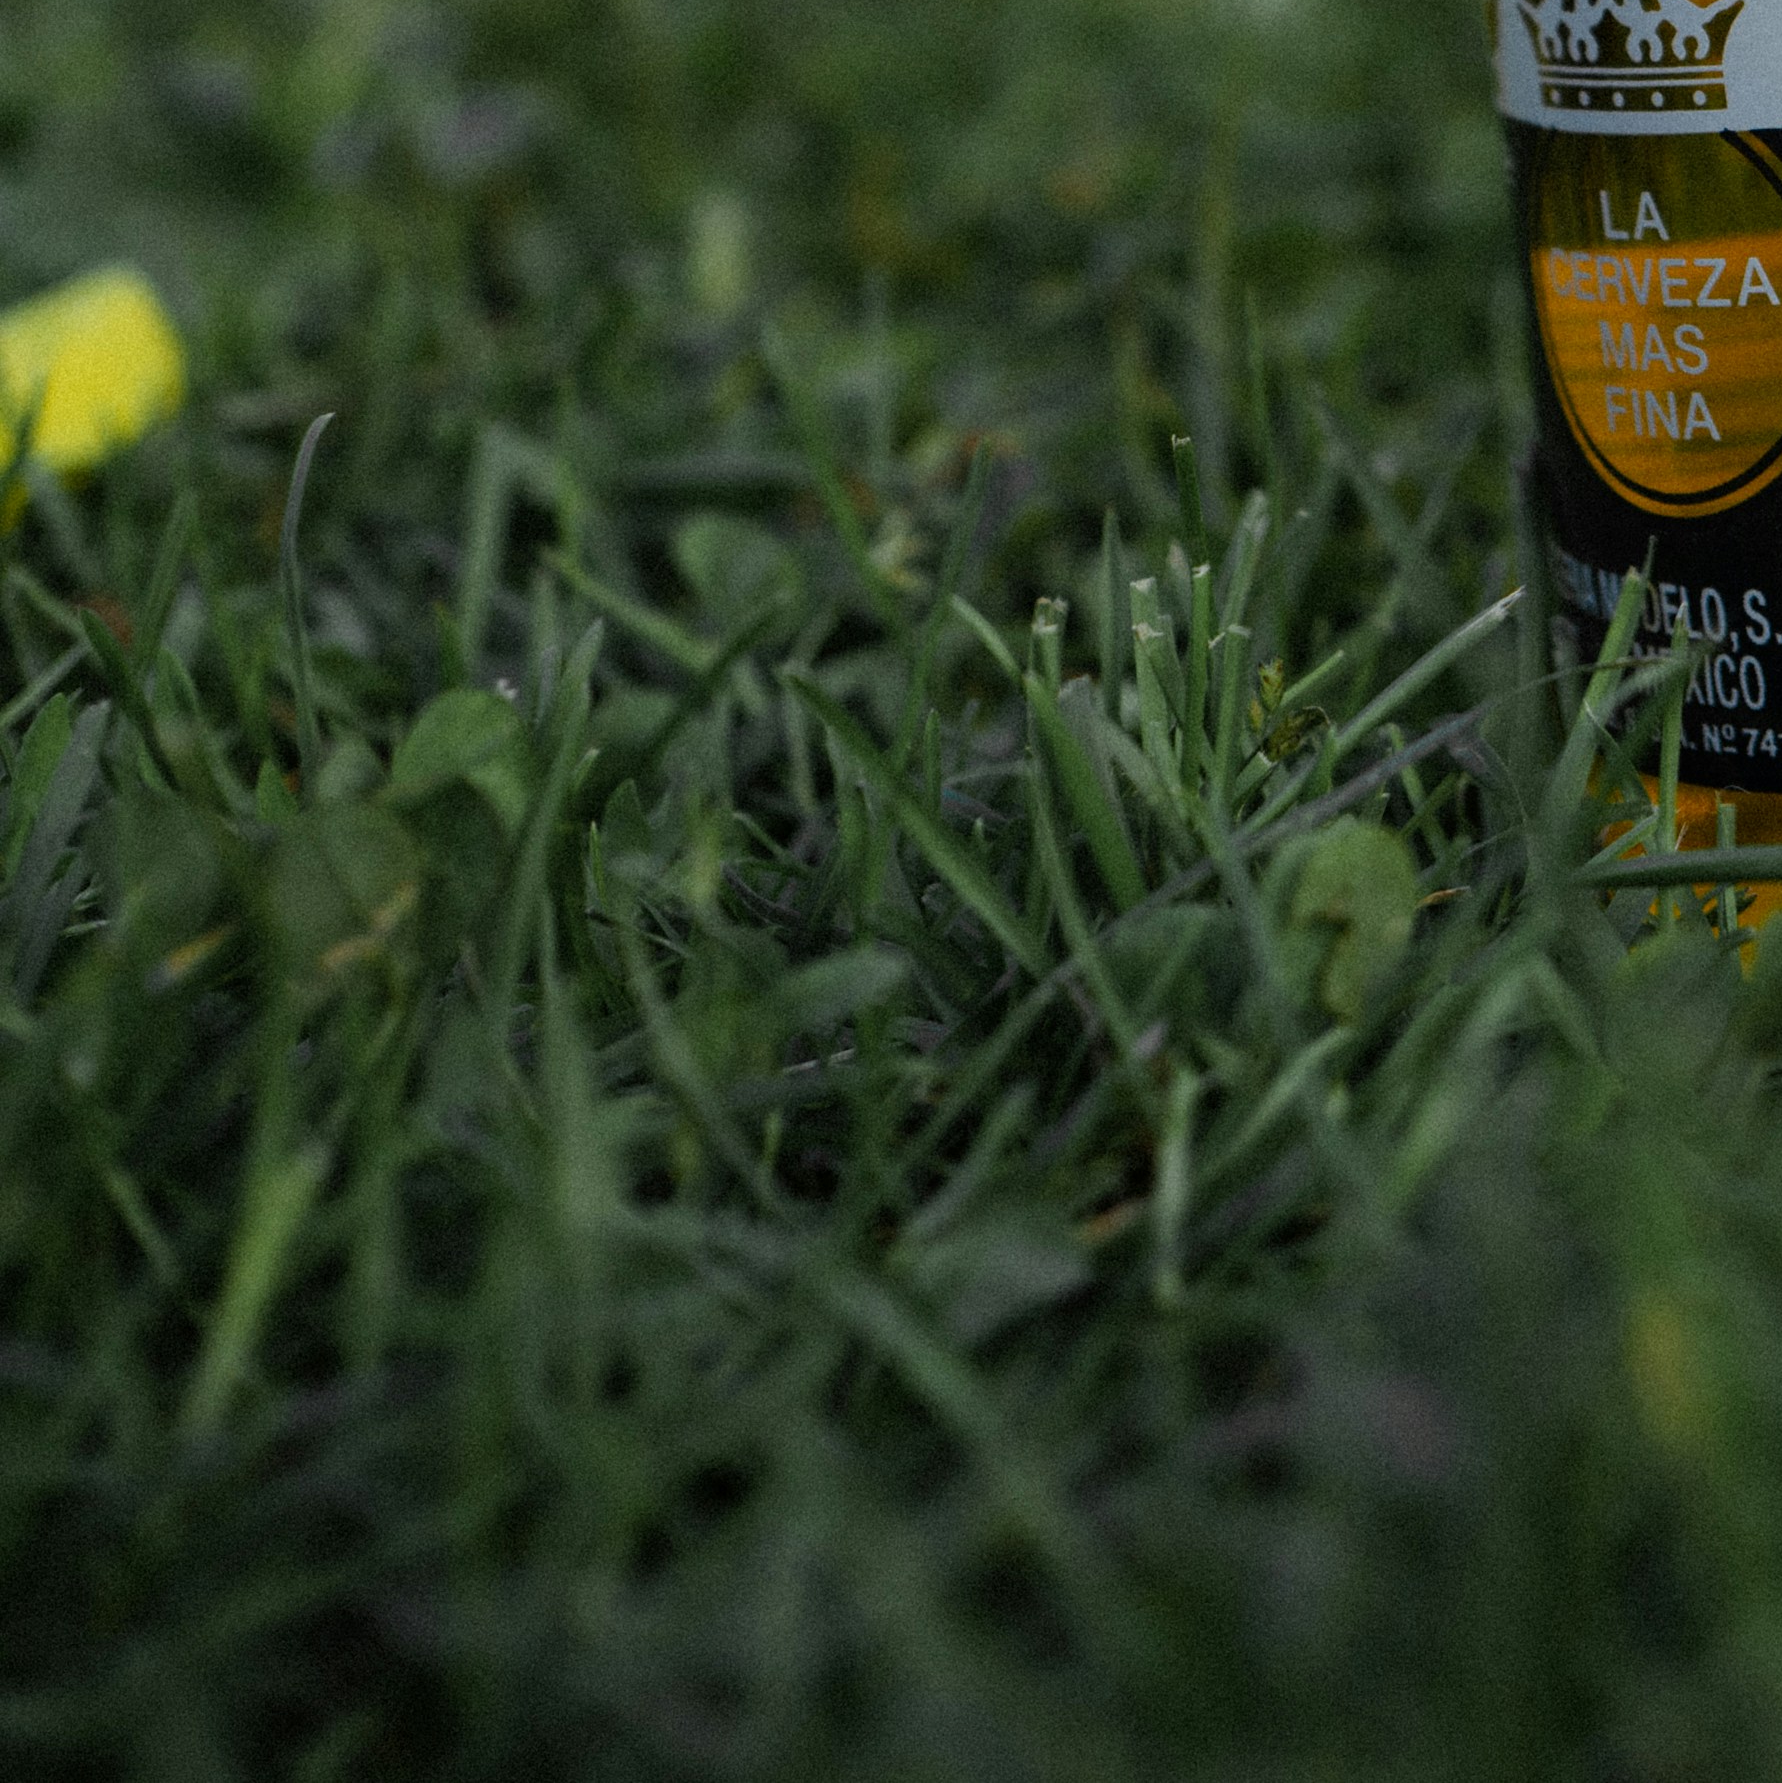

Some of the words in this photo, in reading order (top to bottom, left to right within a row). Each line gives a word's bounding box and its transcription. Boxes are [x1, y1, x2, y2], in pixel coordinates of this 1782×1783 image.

[1598, 189, 1672, 242] LA
[1548, 246, 1782, 308] CERVEZA
[1597, 319, 1710, 376] MAS
[1603, 385, 1723, 443] FINA
[1597, 567, 1740, 653] DELO,
[1633, 640, 1767, 711] XICO
